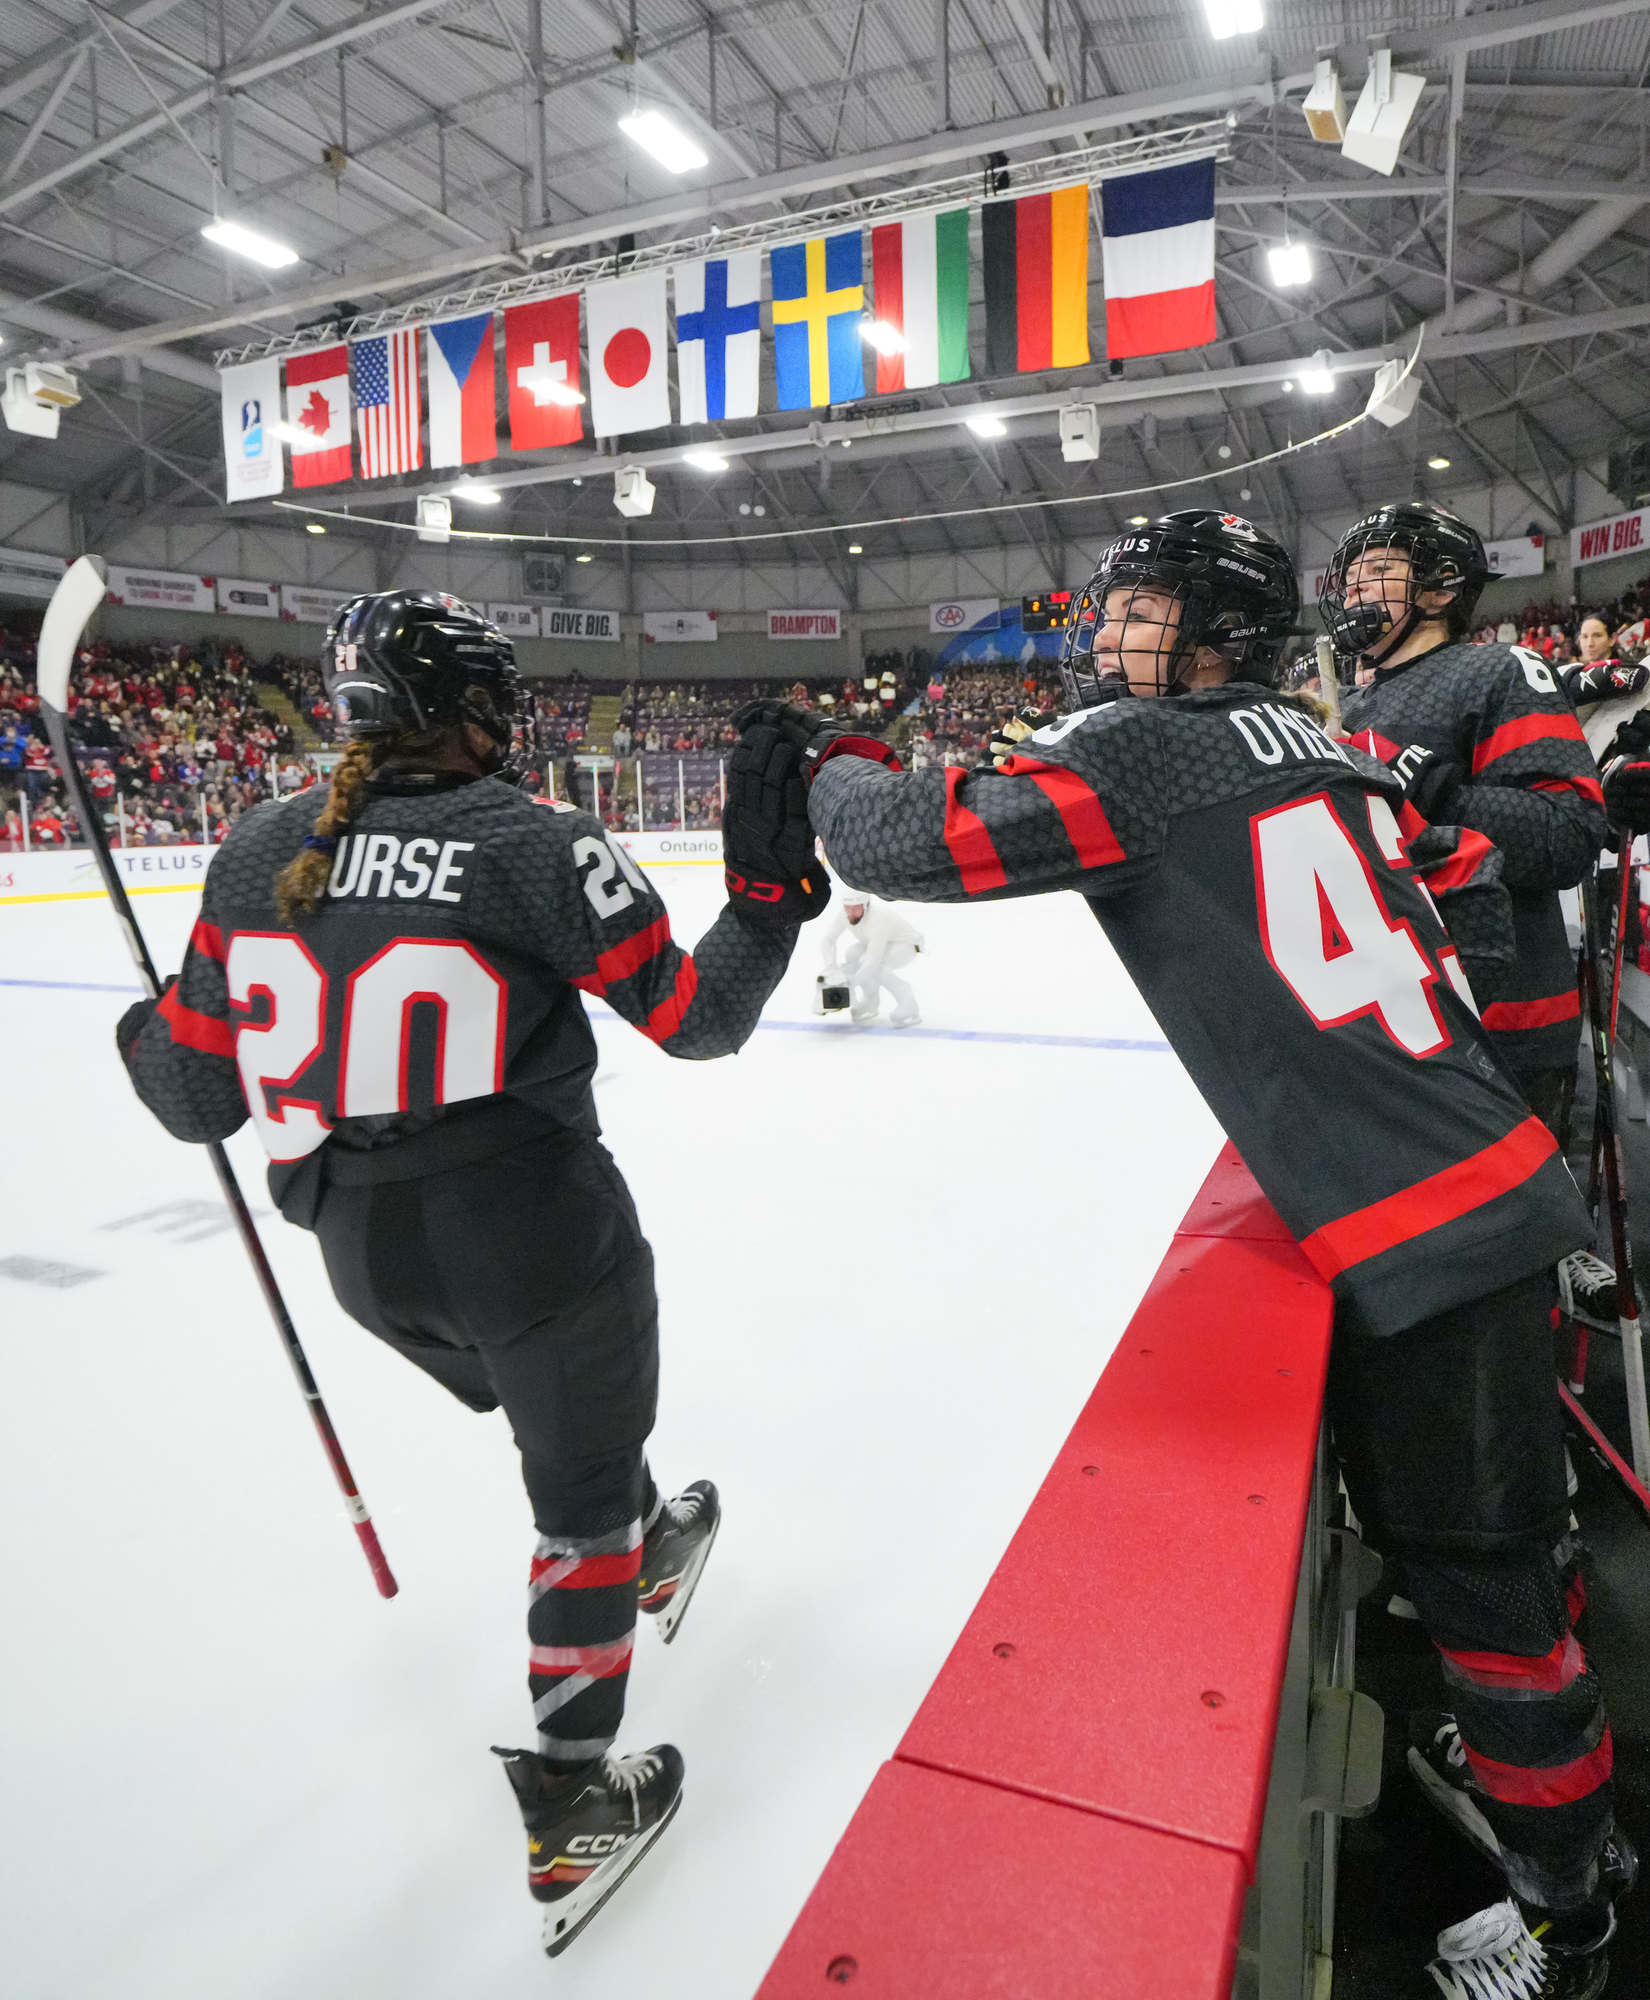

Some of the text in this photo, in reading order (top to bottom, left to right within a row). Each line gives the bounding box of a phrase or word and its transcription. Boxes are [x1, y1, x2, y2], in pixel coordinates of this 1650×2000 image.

[1580, 516, 1644, 560] WIN BIG.
[1216, 557, 1267, 583] BAUER
[551, 612, 613, 637] GIVE BIG.
[771, 615, 837, 635] BRAMPTON
[660, 840, 718, 853] Ontario
[124, 854, 204, 873] TELUS
[325, 833, 475, 902] URSE
[225, 929, 508, 1165] 20
